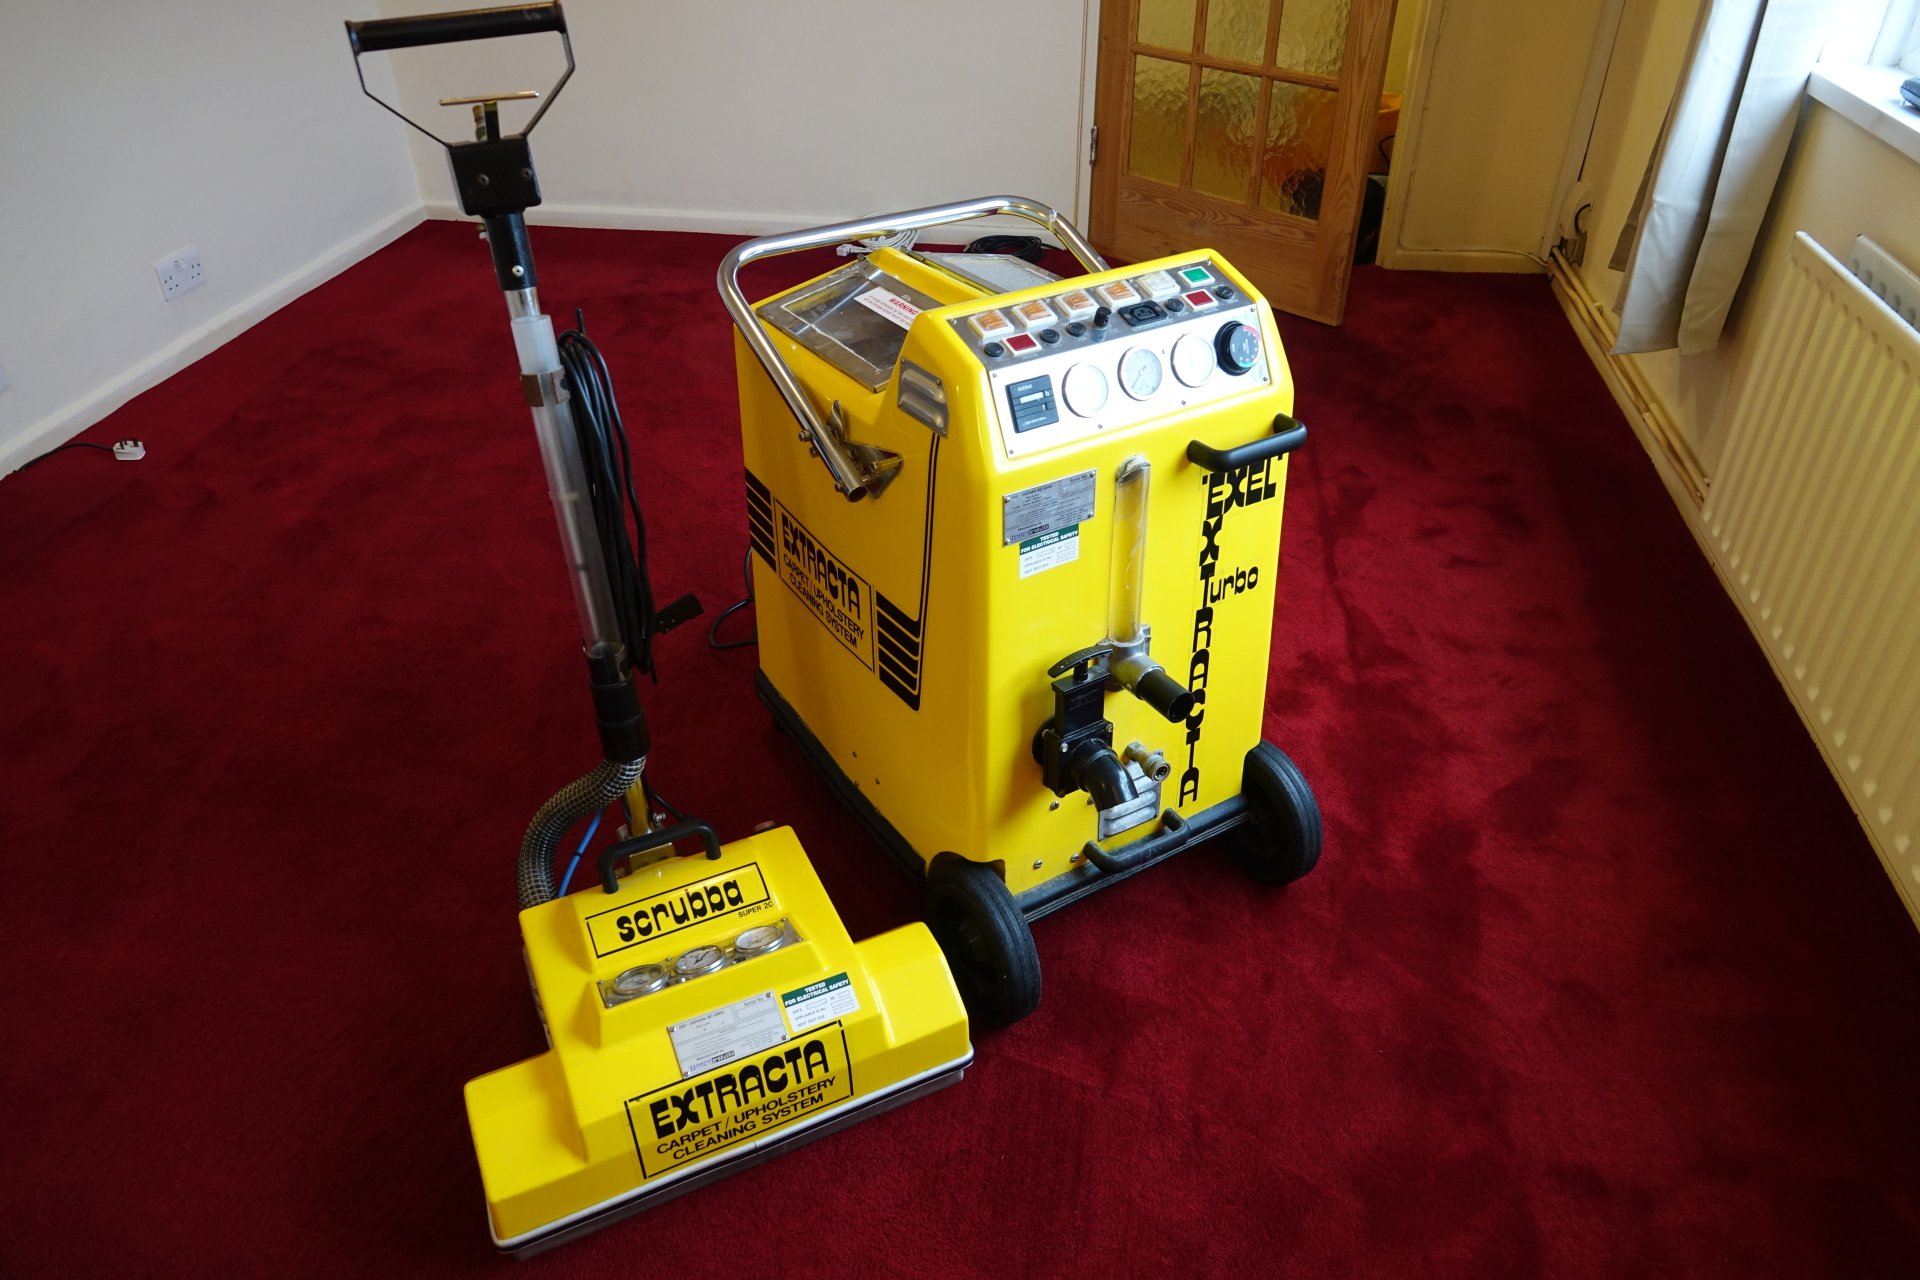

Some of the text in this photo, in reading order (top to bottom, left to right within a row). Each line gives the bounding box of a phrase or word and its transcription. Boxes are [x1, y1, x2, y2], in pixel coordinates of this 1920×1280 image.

[889, 297, 919, 315] WARNING
[781, 512, 860, 620] EXTRACTA
[1020, 545, 1031, 554] FOR
[1031, 536, 1060, 551] ELECTRICAL
[1060, 530, 1078, 541] SAFETY
[1039, 531, 1060, 543] TESTED
[783, 553, 810, 588] CARPET
[813, 582, 864, 640] UPHOLSTERY
[790, 573, 858, 649] CLEANING SYSTEM
[616, 879, 744, 943] scrubba
[737, 905, 763, 919] SUPER
[784, 978, 849, 1007] FOR ELECTRICAL SAFETY
[803, 981, 826, 993] TESTED
[649, 1039, 830, 1140] EXTRACTA
[656, 1119, 724, 1155] CARPET
[733, 1075, 837, 1125] UPHOLSTERY
[672, 1092, 824, 1160] CLEANING SYSTEM
